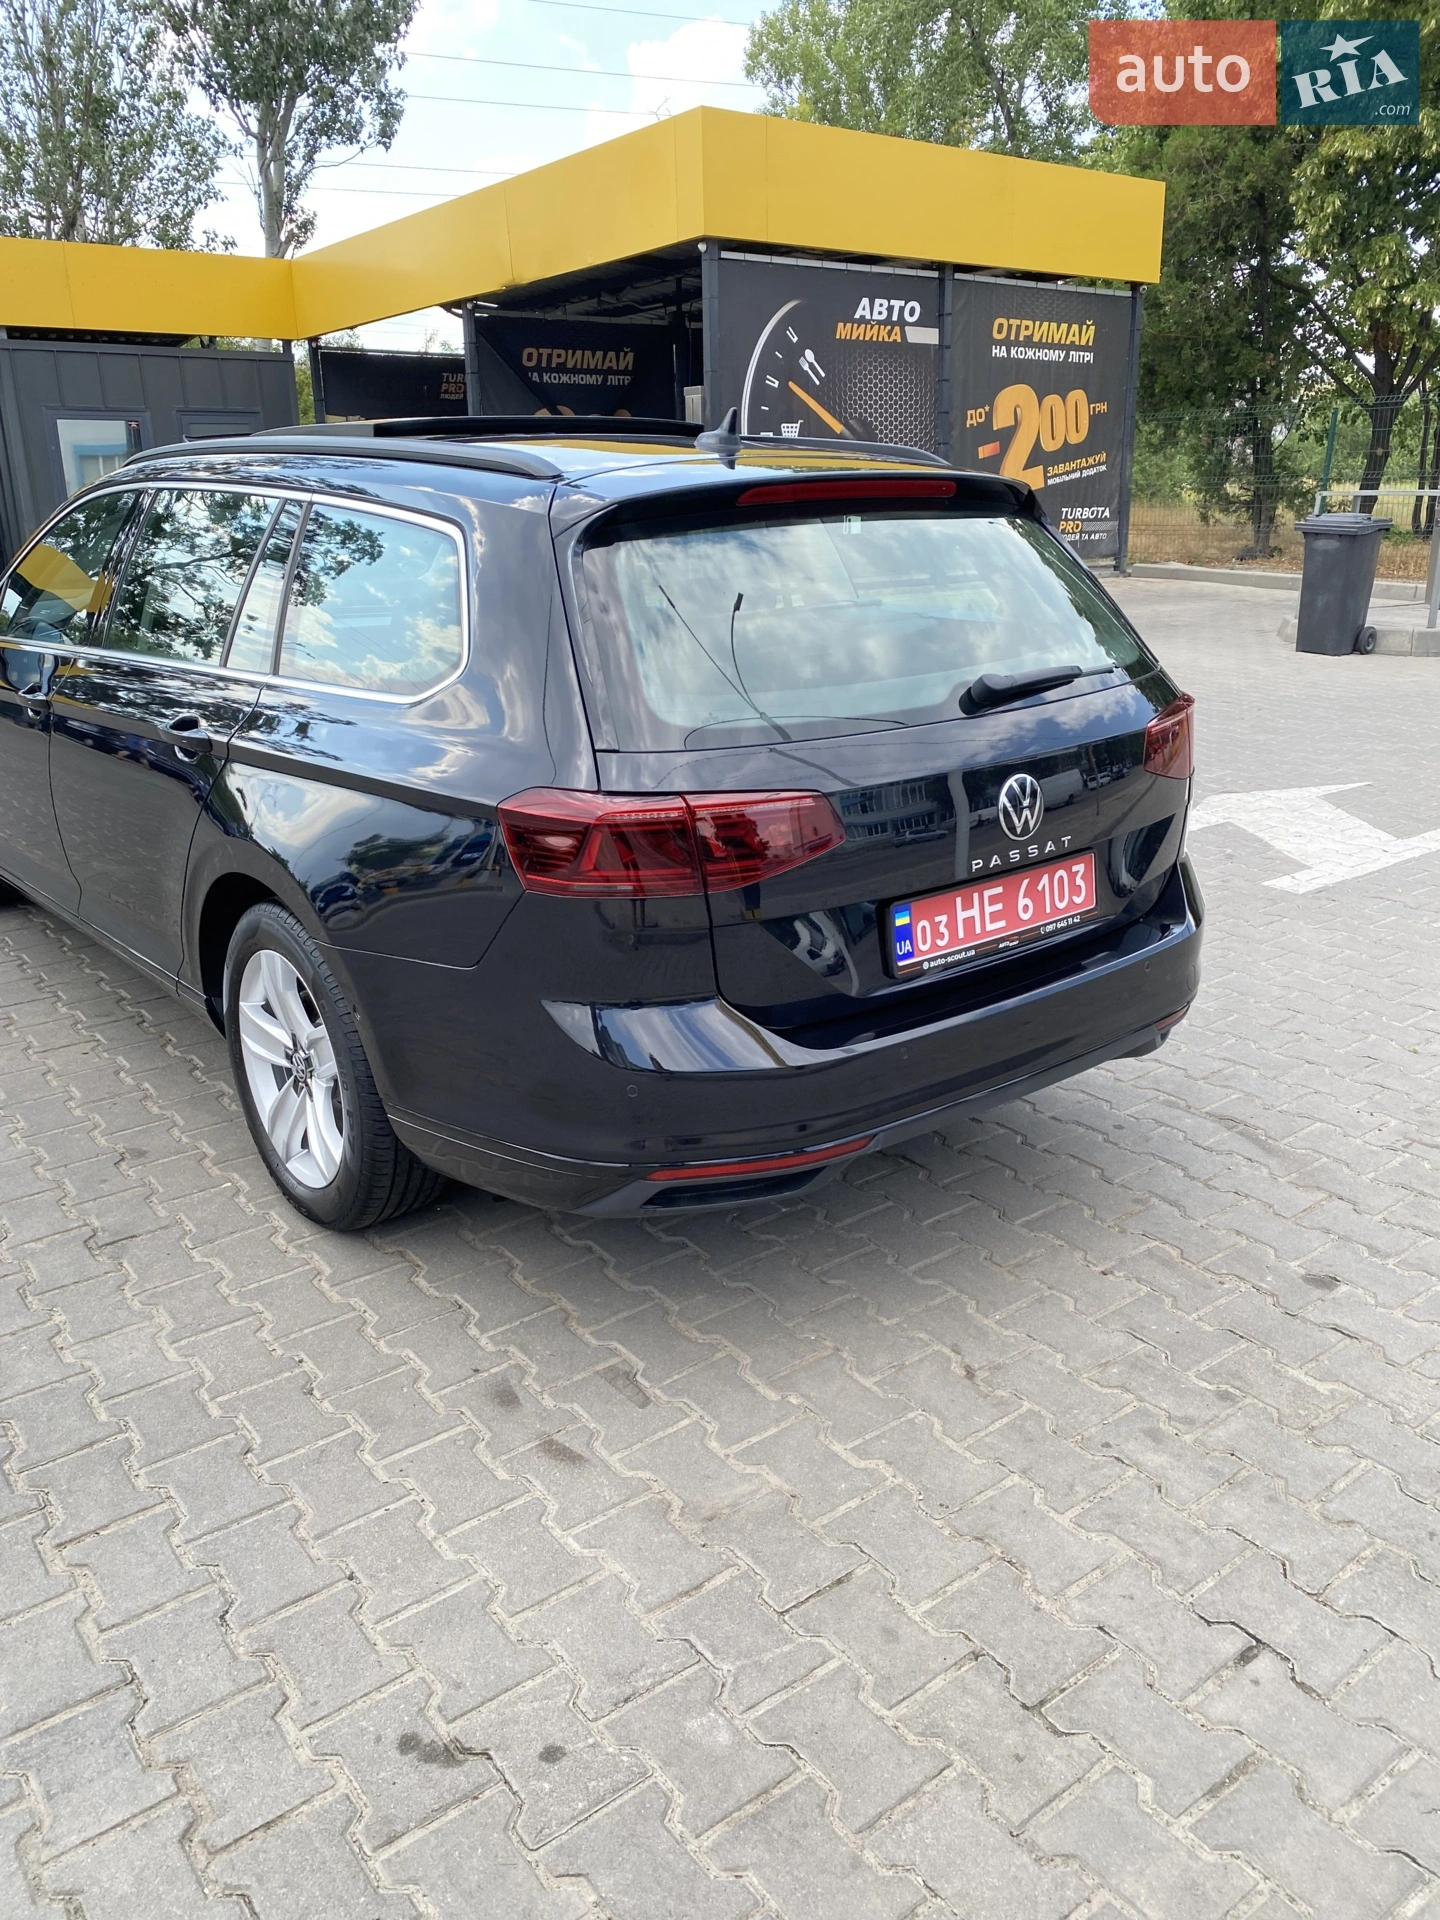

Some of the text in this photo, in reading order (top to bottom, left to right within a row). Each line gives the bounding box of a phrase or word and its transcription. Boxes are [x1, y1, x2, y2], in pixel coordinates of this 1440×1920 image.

[853, 297, 921, 322] АВТО
[835, 320, 902, 342] МИЙКА
[992, 317, 1096, 346] ОТРИМАЙ
[522, 346, 634, 371] ОТРИМАЙ
[991, 345, 1094, 364] НА КОЖНОМУ ЛІТРІ
[441, 382, 465, 393] PRO
[543, 372, 604, 385] КОЖНОМУ
[606, 375, 634, 386] ЛІТР
[1089, 402, 1108, 416] ГРН
[1046, 451, 1107, 477] ЗАВАНТАЖУЙ
[1047, 464, 1107, 486] МОБІЛЬНИЙ ДОДАТОК
[1061, 507, 1110, 520] TURBOTA
[1058, 521, 1082, 534] PRO
[971, 835, 1072, 873] PASSAT
[897, 863, 1086, 955] UA 03 HE 6103
[929, 949, 976, 968] auto-scout.ua
